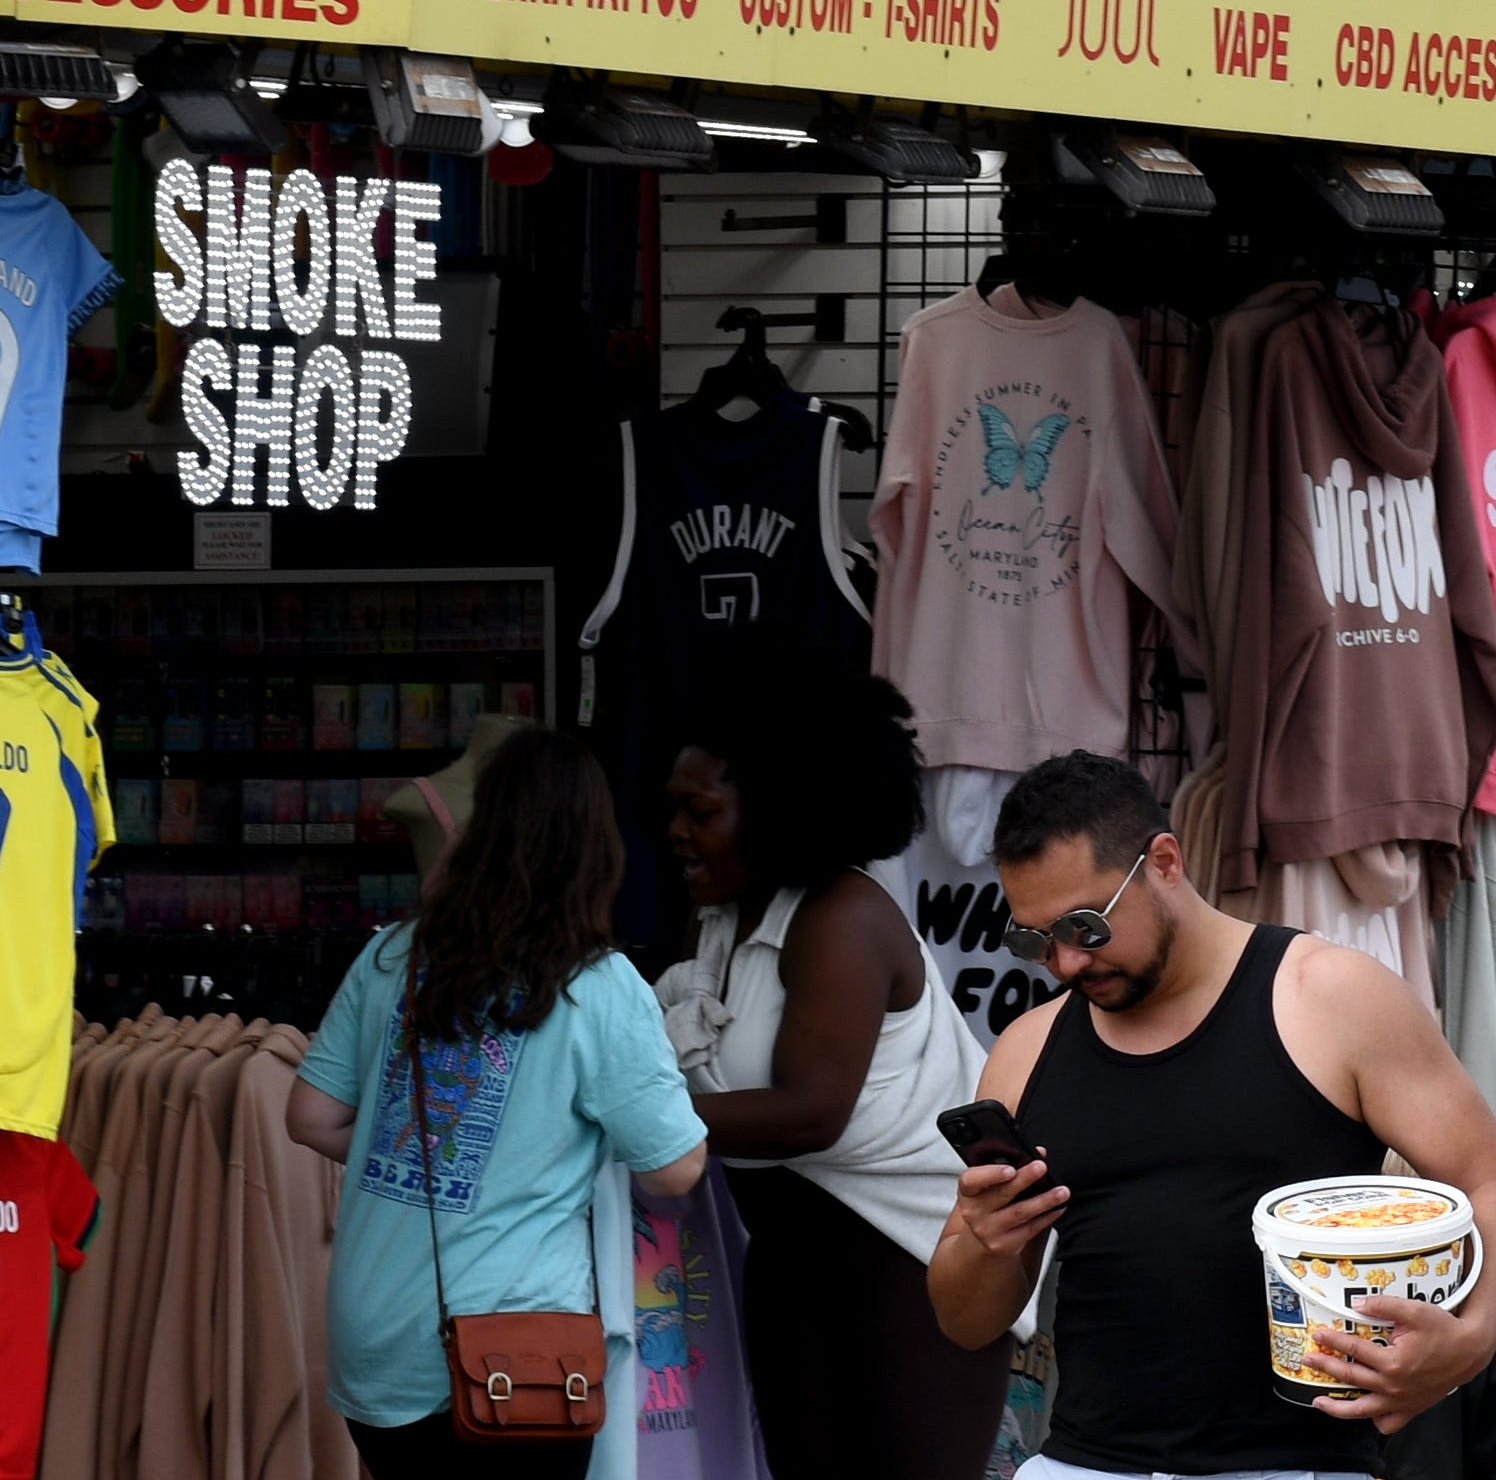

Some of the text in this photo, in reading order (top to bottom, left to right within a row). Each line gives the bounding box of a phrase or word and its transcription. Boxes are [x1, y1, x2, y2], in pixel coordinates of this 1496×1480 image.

[1213, 7, 1291, 81] VAPE
[1336, 24, 1395, 89] CBD
[154, 158, 441, 342] SMOKE
[177, 338, 412, 510] SHOP
[975, 382, 1041, 405] SUMMER
[935, 407, 972, 489] ENDLESS
[670, 503, 795, 563] DURANT
[958, 499, 1080, 558] Ocean City
[967, 581, 1022, 606] STATE
